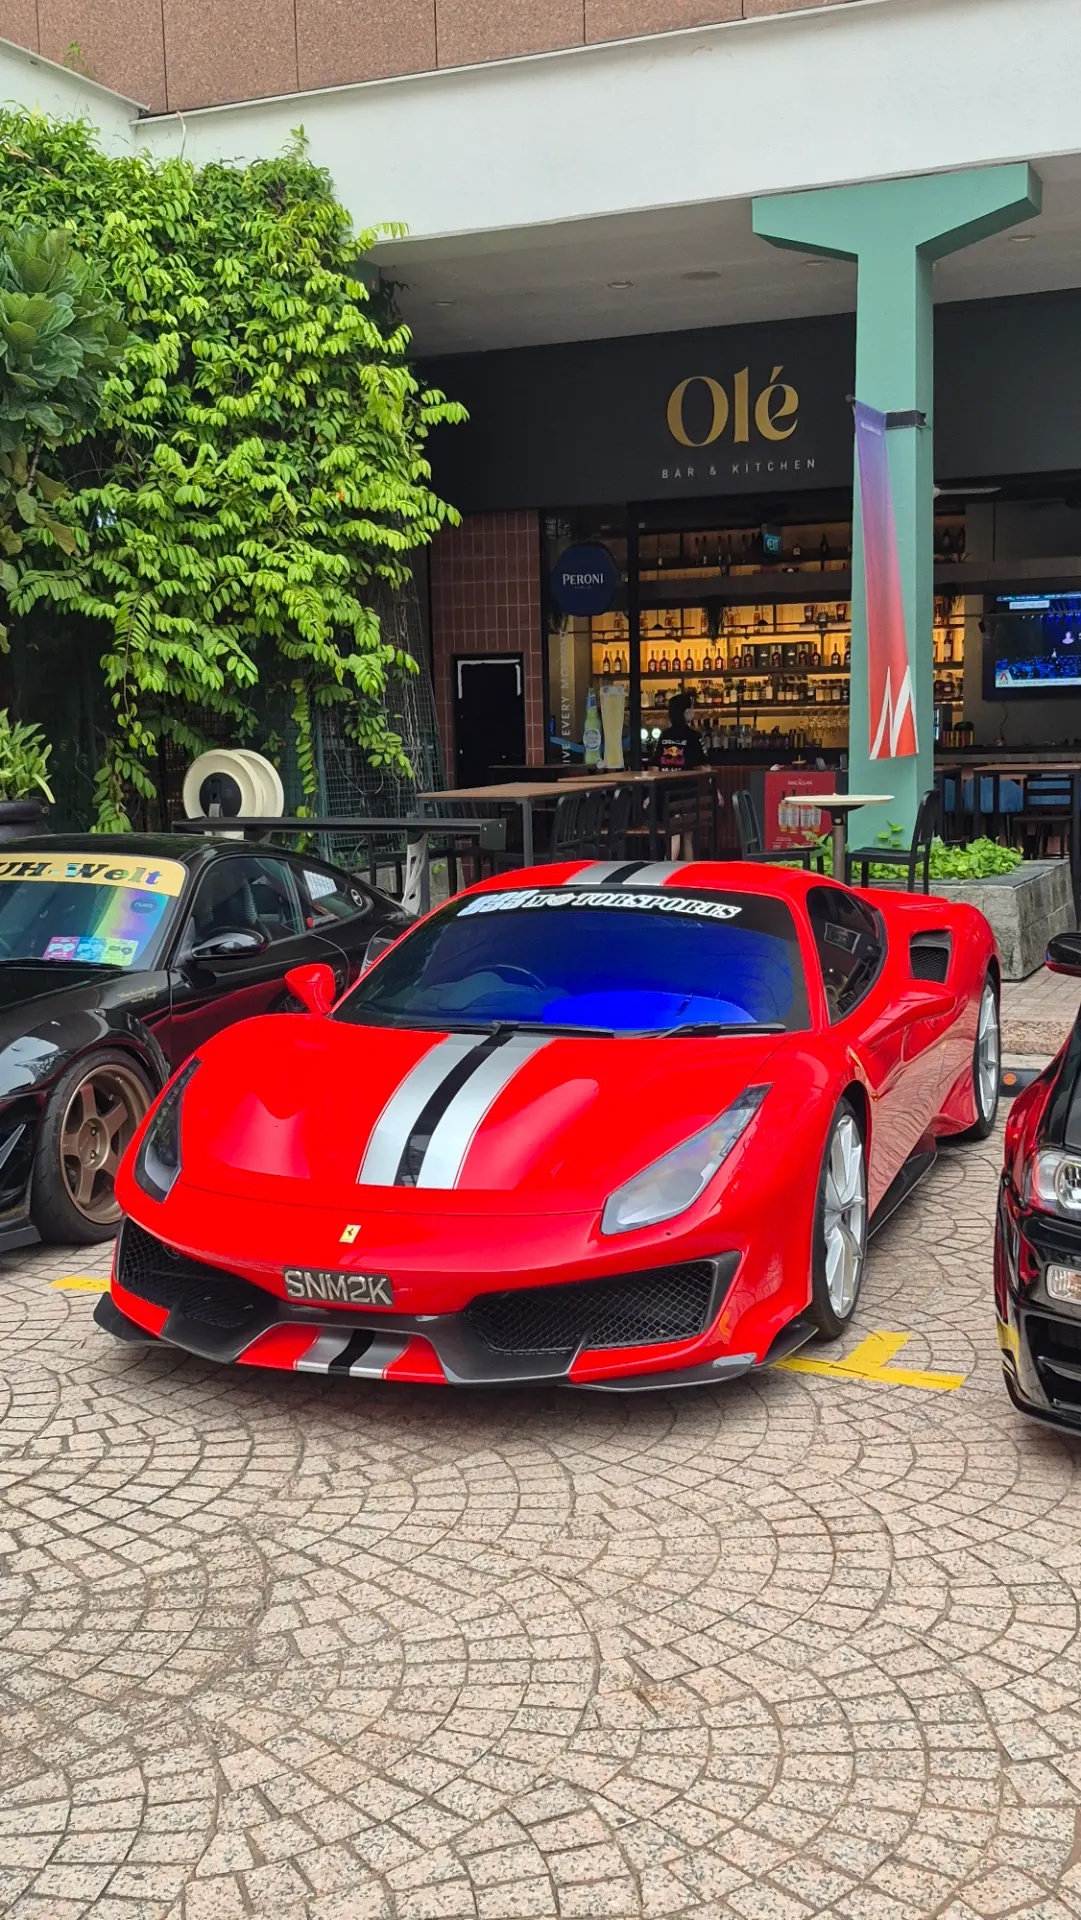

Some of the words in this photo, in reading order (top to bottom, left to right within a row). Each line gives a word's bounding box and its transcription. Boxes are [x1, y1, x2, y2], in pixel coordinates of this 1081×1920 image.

[667, 366, 799, 447] Olé
[661, 467, 694, 479] BAR
[709, 466, 716, 476] &
[732, 459, 815, 474] KITCHEN
[562, 573, 604, 585] PERONI
[562, 696, 571, 736] EVERY
[284, 1270, 393, 1306] SNM2K
